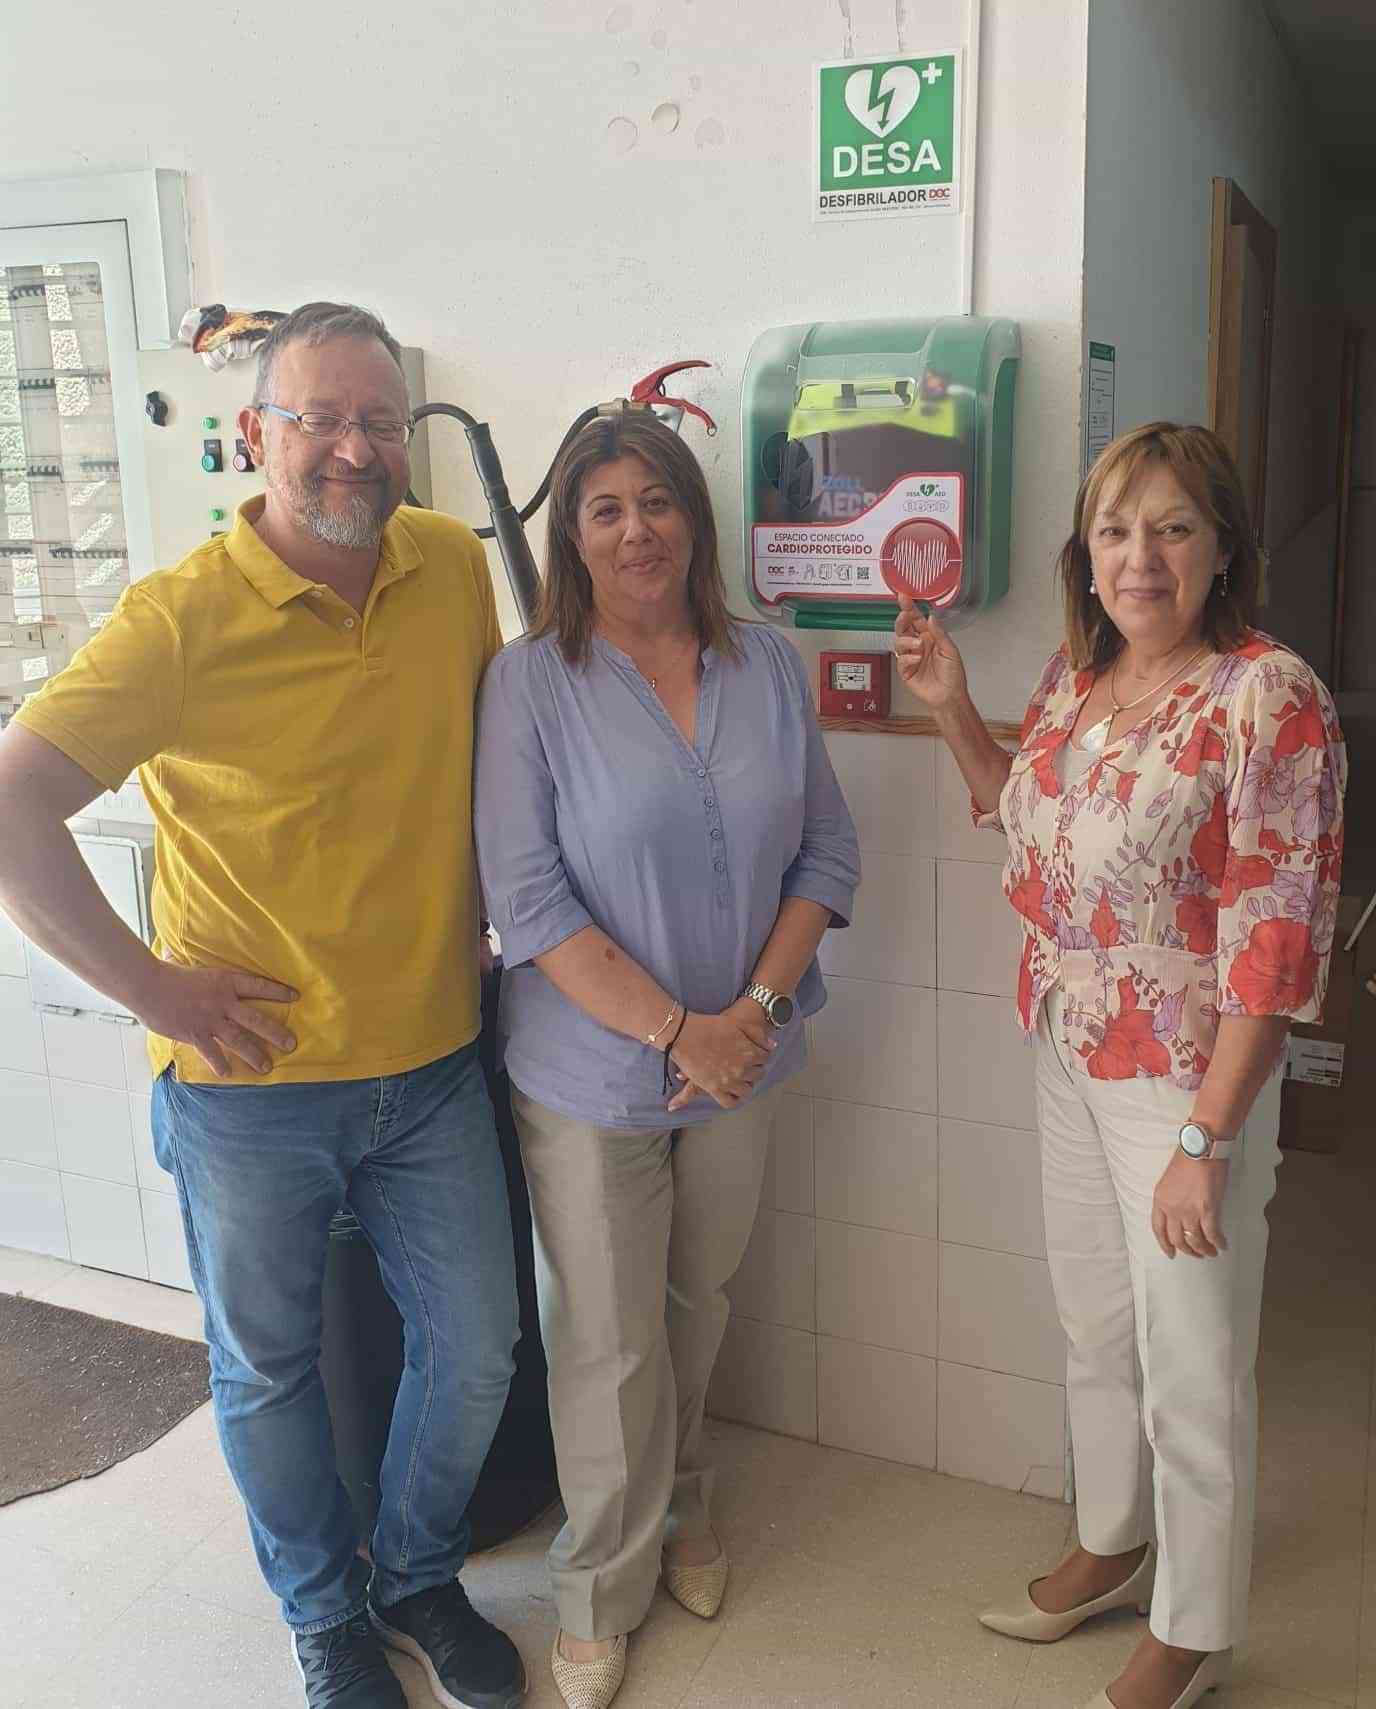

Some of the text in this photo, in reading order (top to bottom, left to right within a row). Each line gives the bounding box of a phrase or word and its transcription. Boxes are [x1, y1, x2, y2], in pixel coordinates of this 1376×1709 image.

[833, 139, 942, 179] DESA
[819, 189, 927, 209] DESFIBRILADOR
[774, 532, 865, 543] ESPACIO CONECTADO
[767, 543, 873, 555] CARDIOPROTEGIDO
